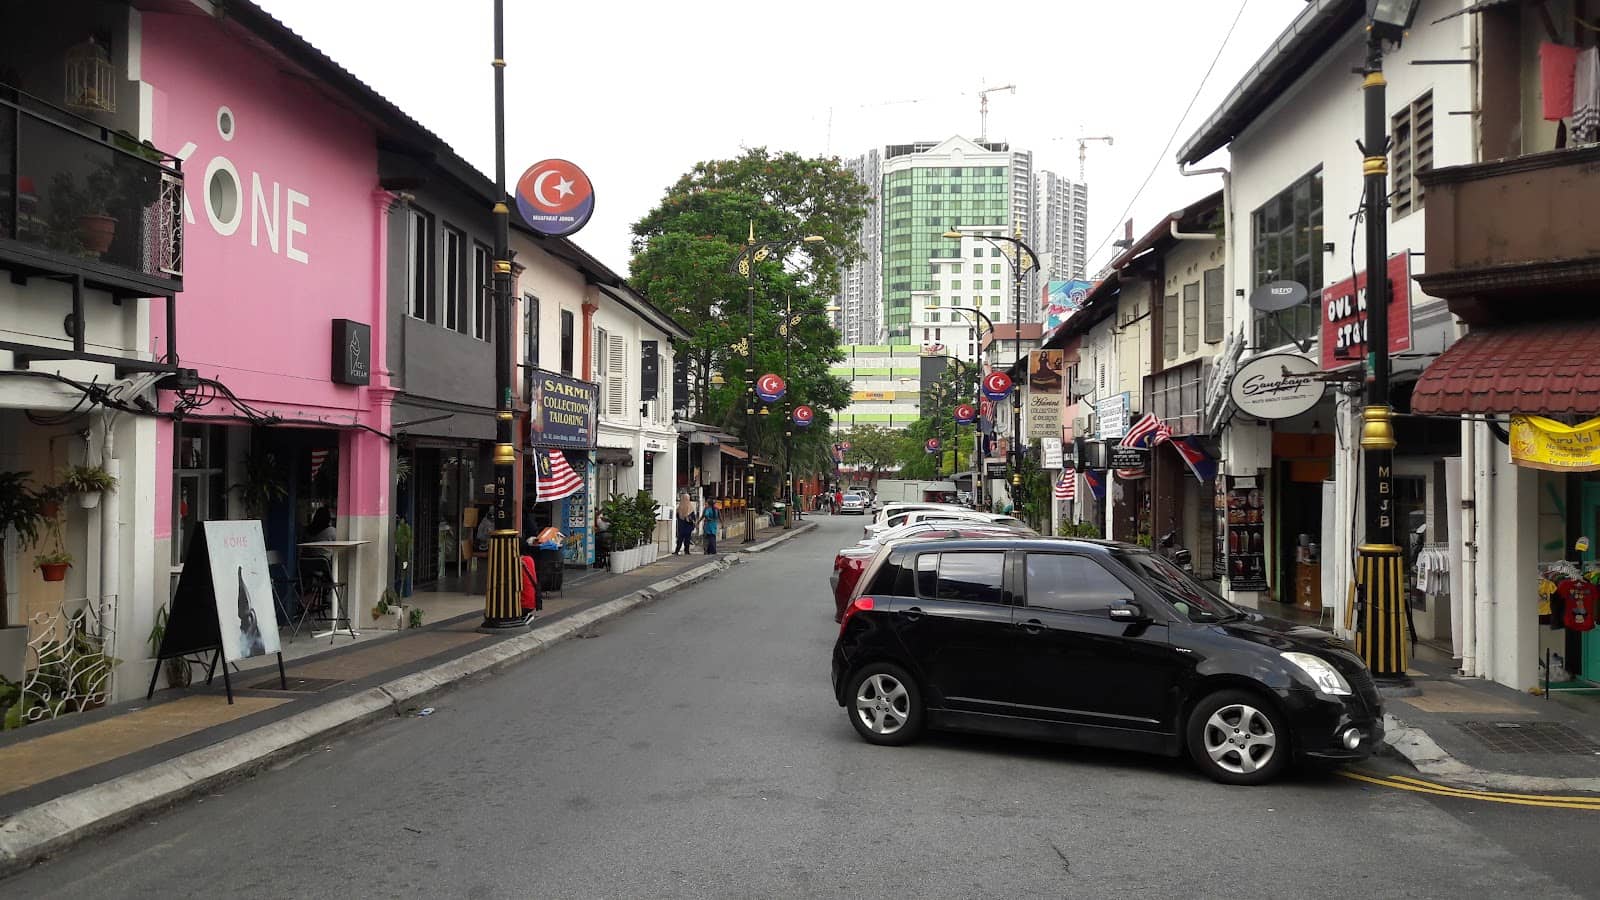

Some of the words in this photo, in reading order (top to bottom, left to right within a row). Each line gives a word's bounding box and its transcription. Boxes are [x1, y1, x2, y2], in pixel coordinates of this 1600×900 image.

[543, 396, 589, 415] COLLECTIONS
[549, 410, 584, 427] TAILORING
[497, 476, 506, 519] MBJB
[1378, 465, 1390, 528] MBJB
